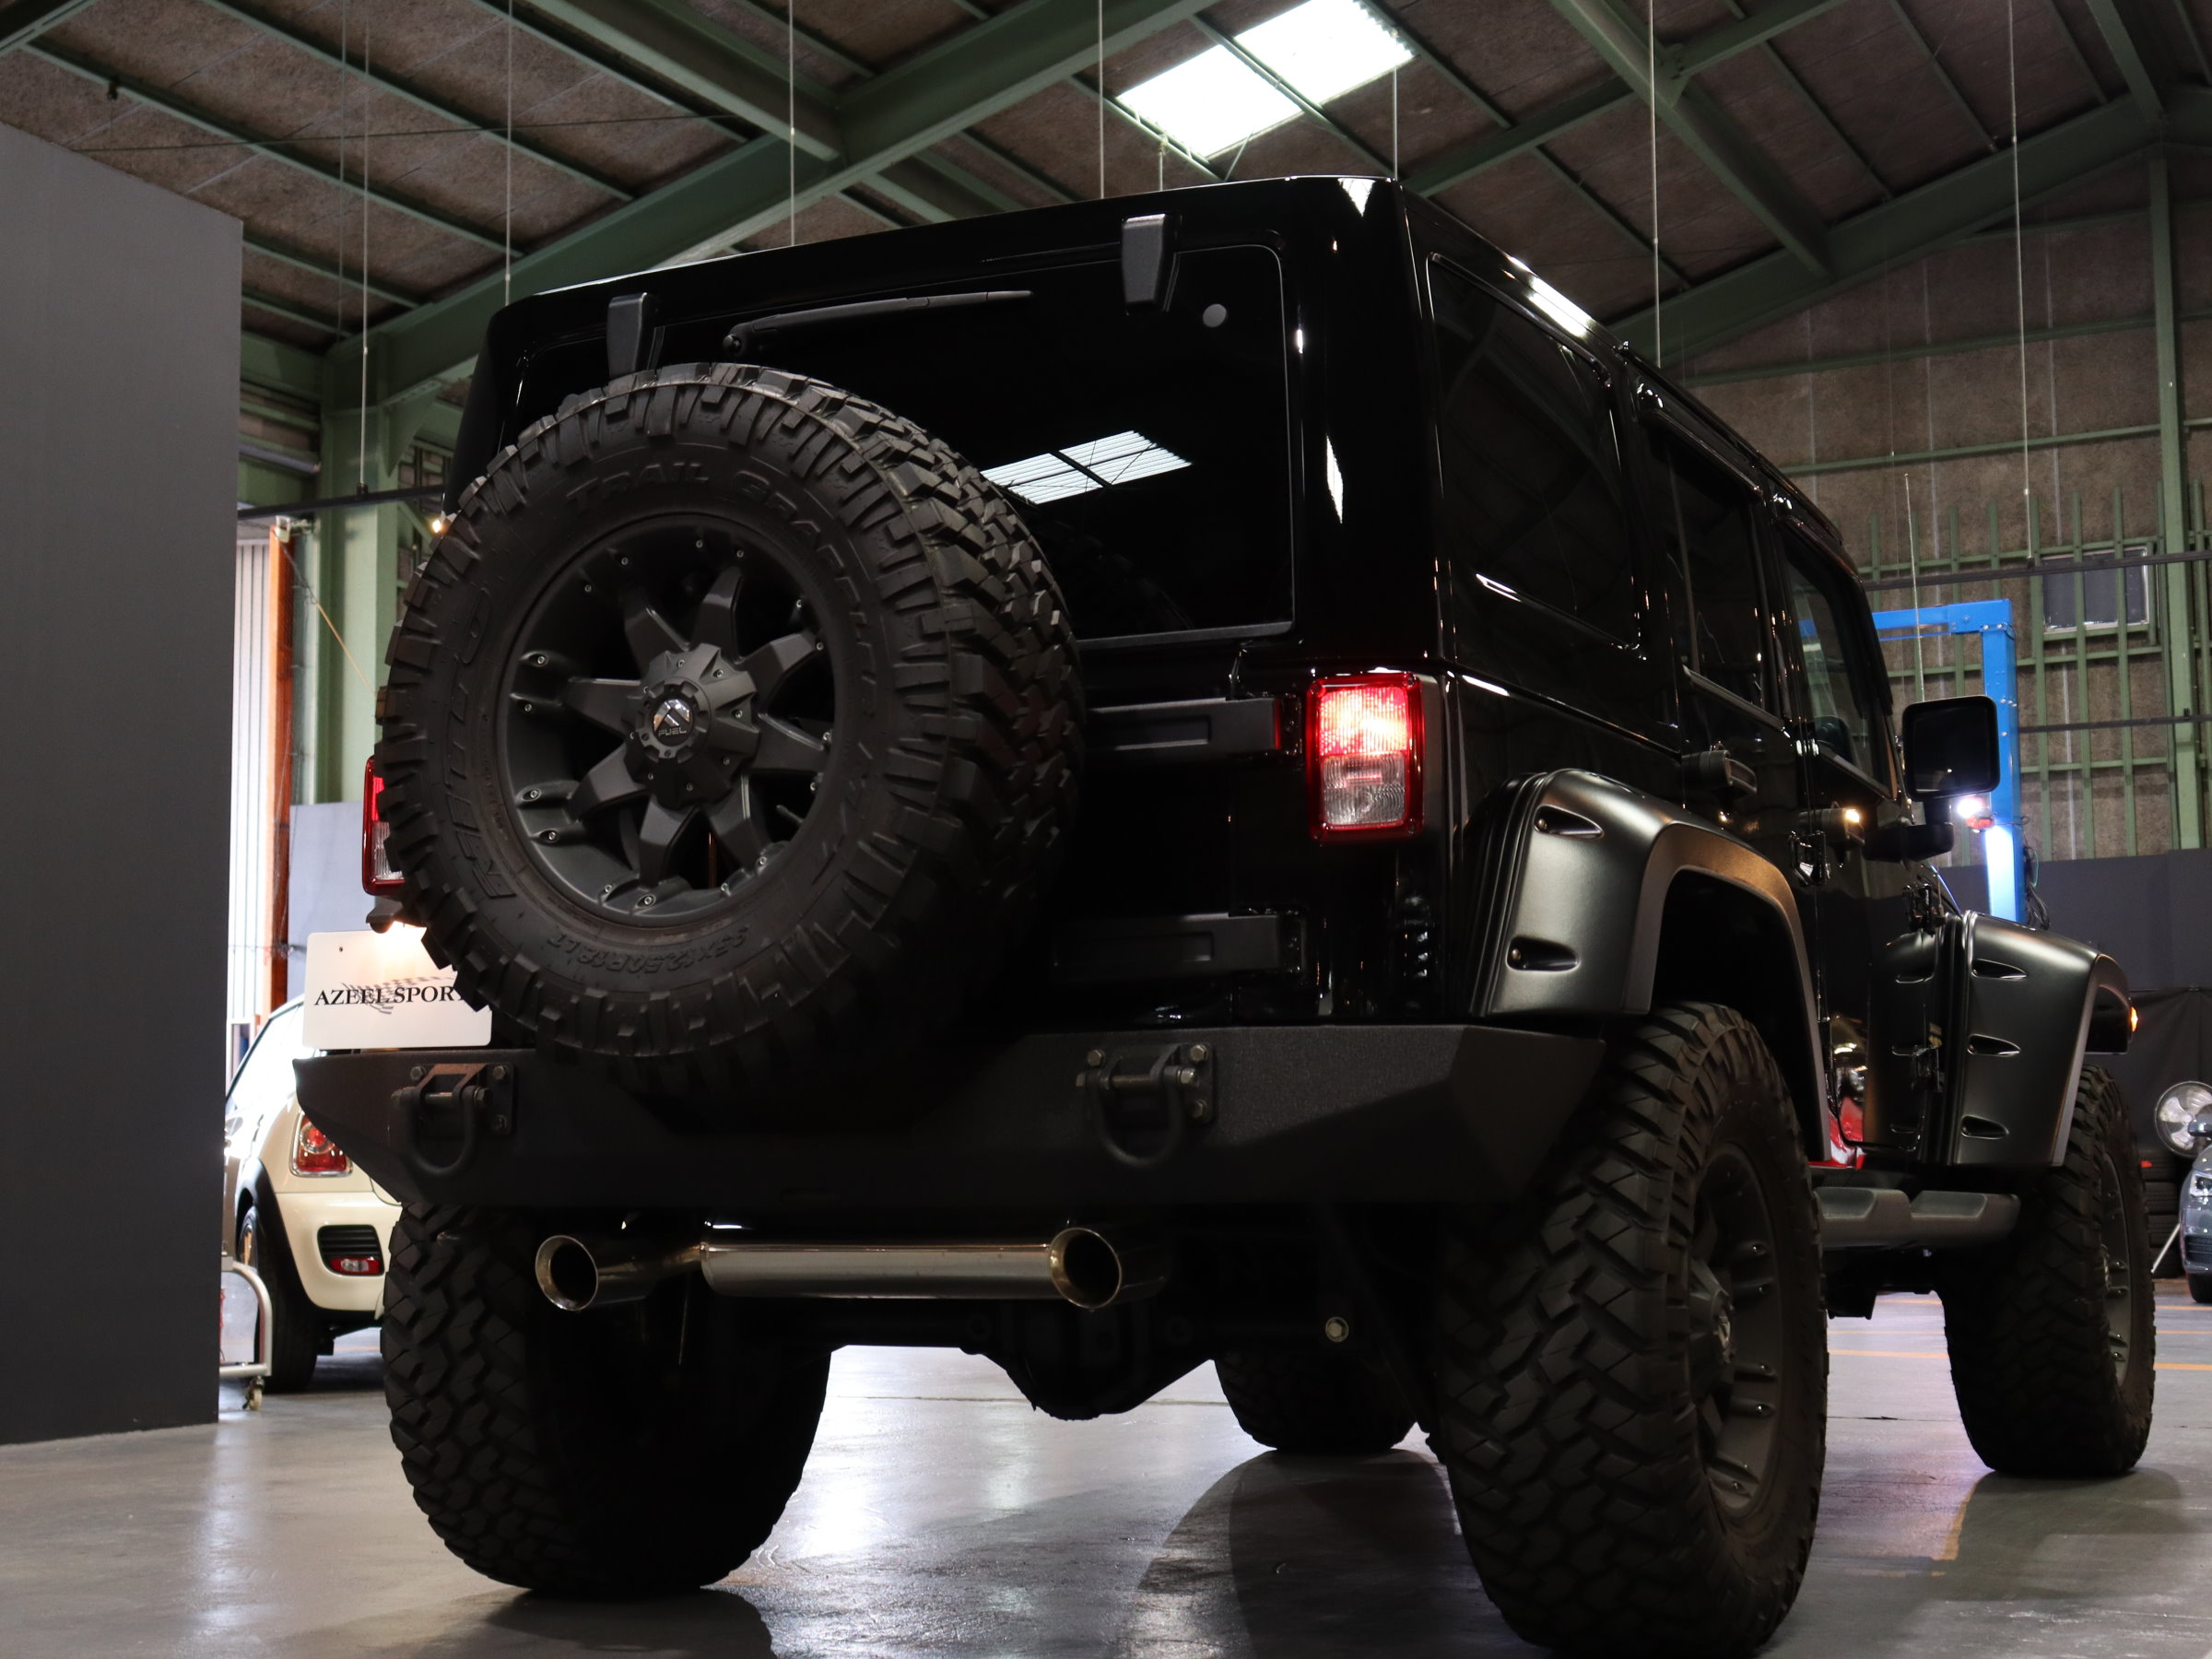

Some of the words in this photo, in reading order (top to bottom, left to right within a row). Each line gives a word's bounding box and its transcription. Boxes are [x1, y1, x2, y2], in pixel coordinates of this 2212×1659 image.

[566, 462, 710, 515] TRAIL
[658, 726, 688, 737] FUEL
[314, 988, 392, 1006] AZEEL
[394, 985, 465, 1004] SPOR
